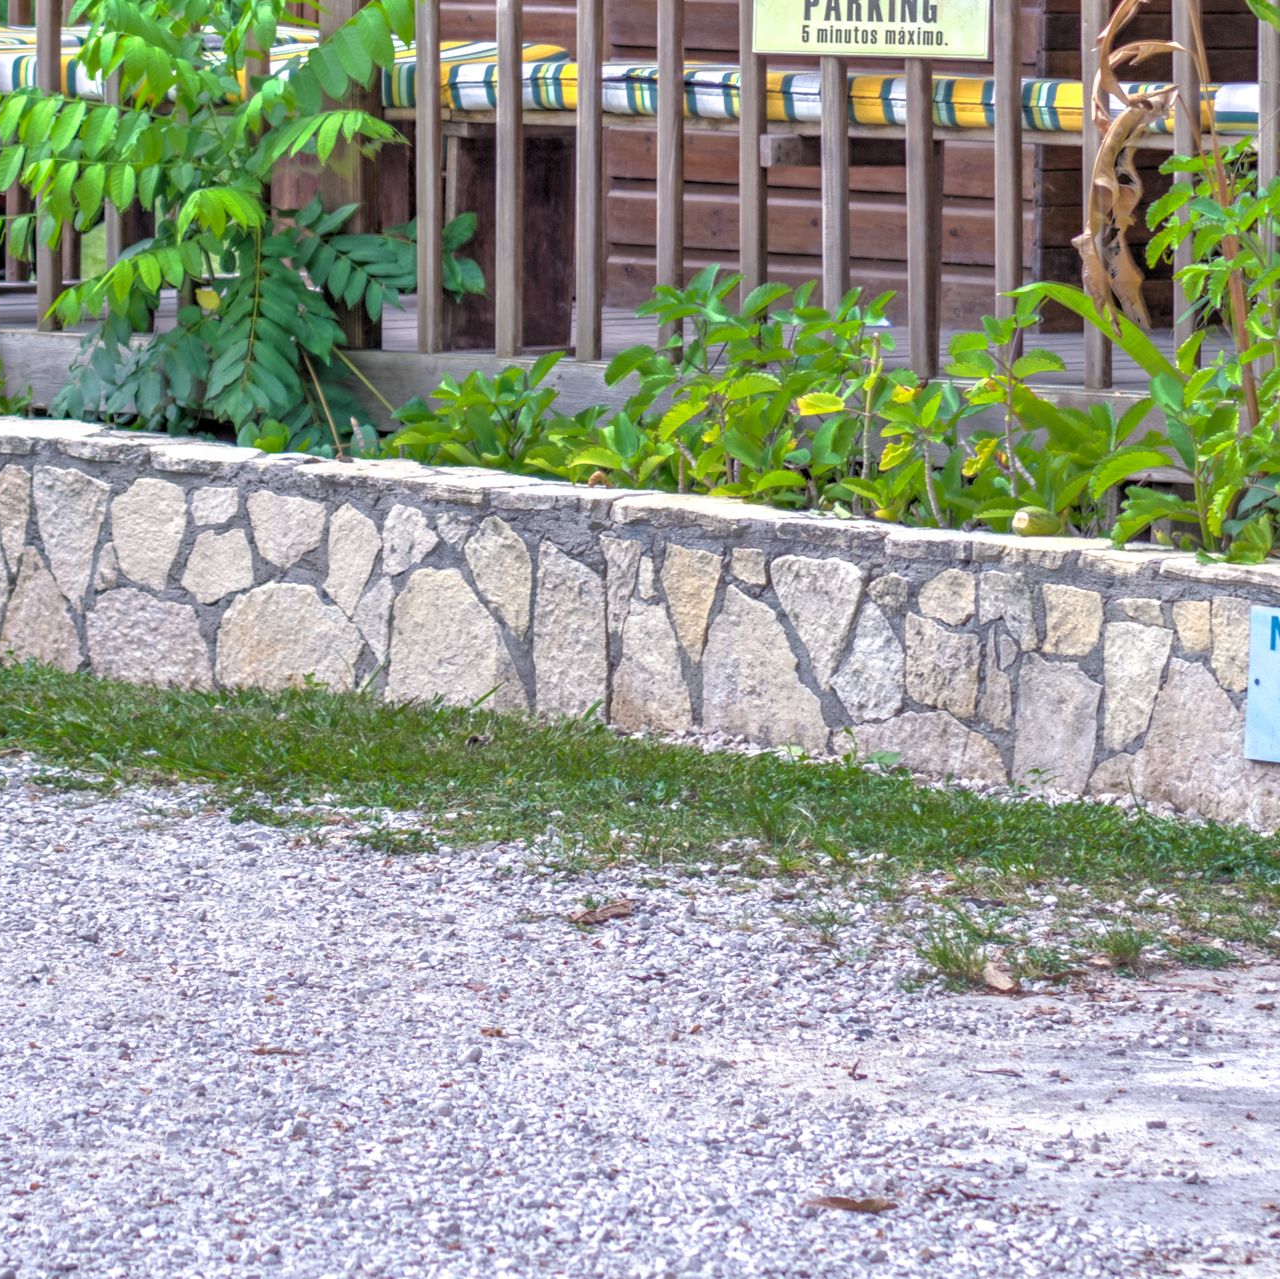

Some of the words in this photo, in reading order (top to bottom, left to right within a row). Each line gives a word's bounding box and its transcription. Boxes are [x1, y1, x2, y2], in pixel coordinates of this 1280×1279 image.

[802, 25, 810, 43] 5
[816, 25, 878, 45] minutos
[885, 26, 949, 46] máximo.
